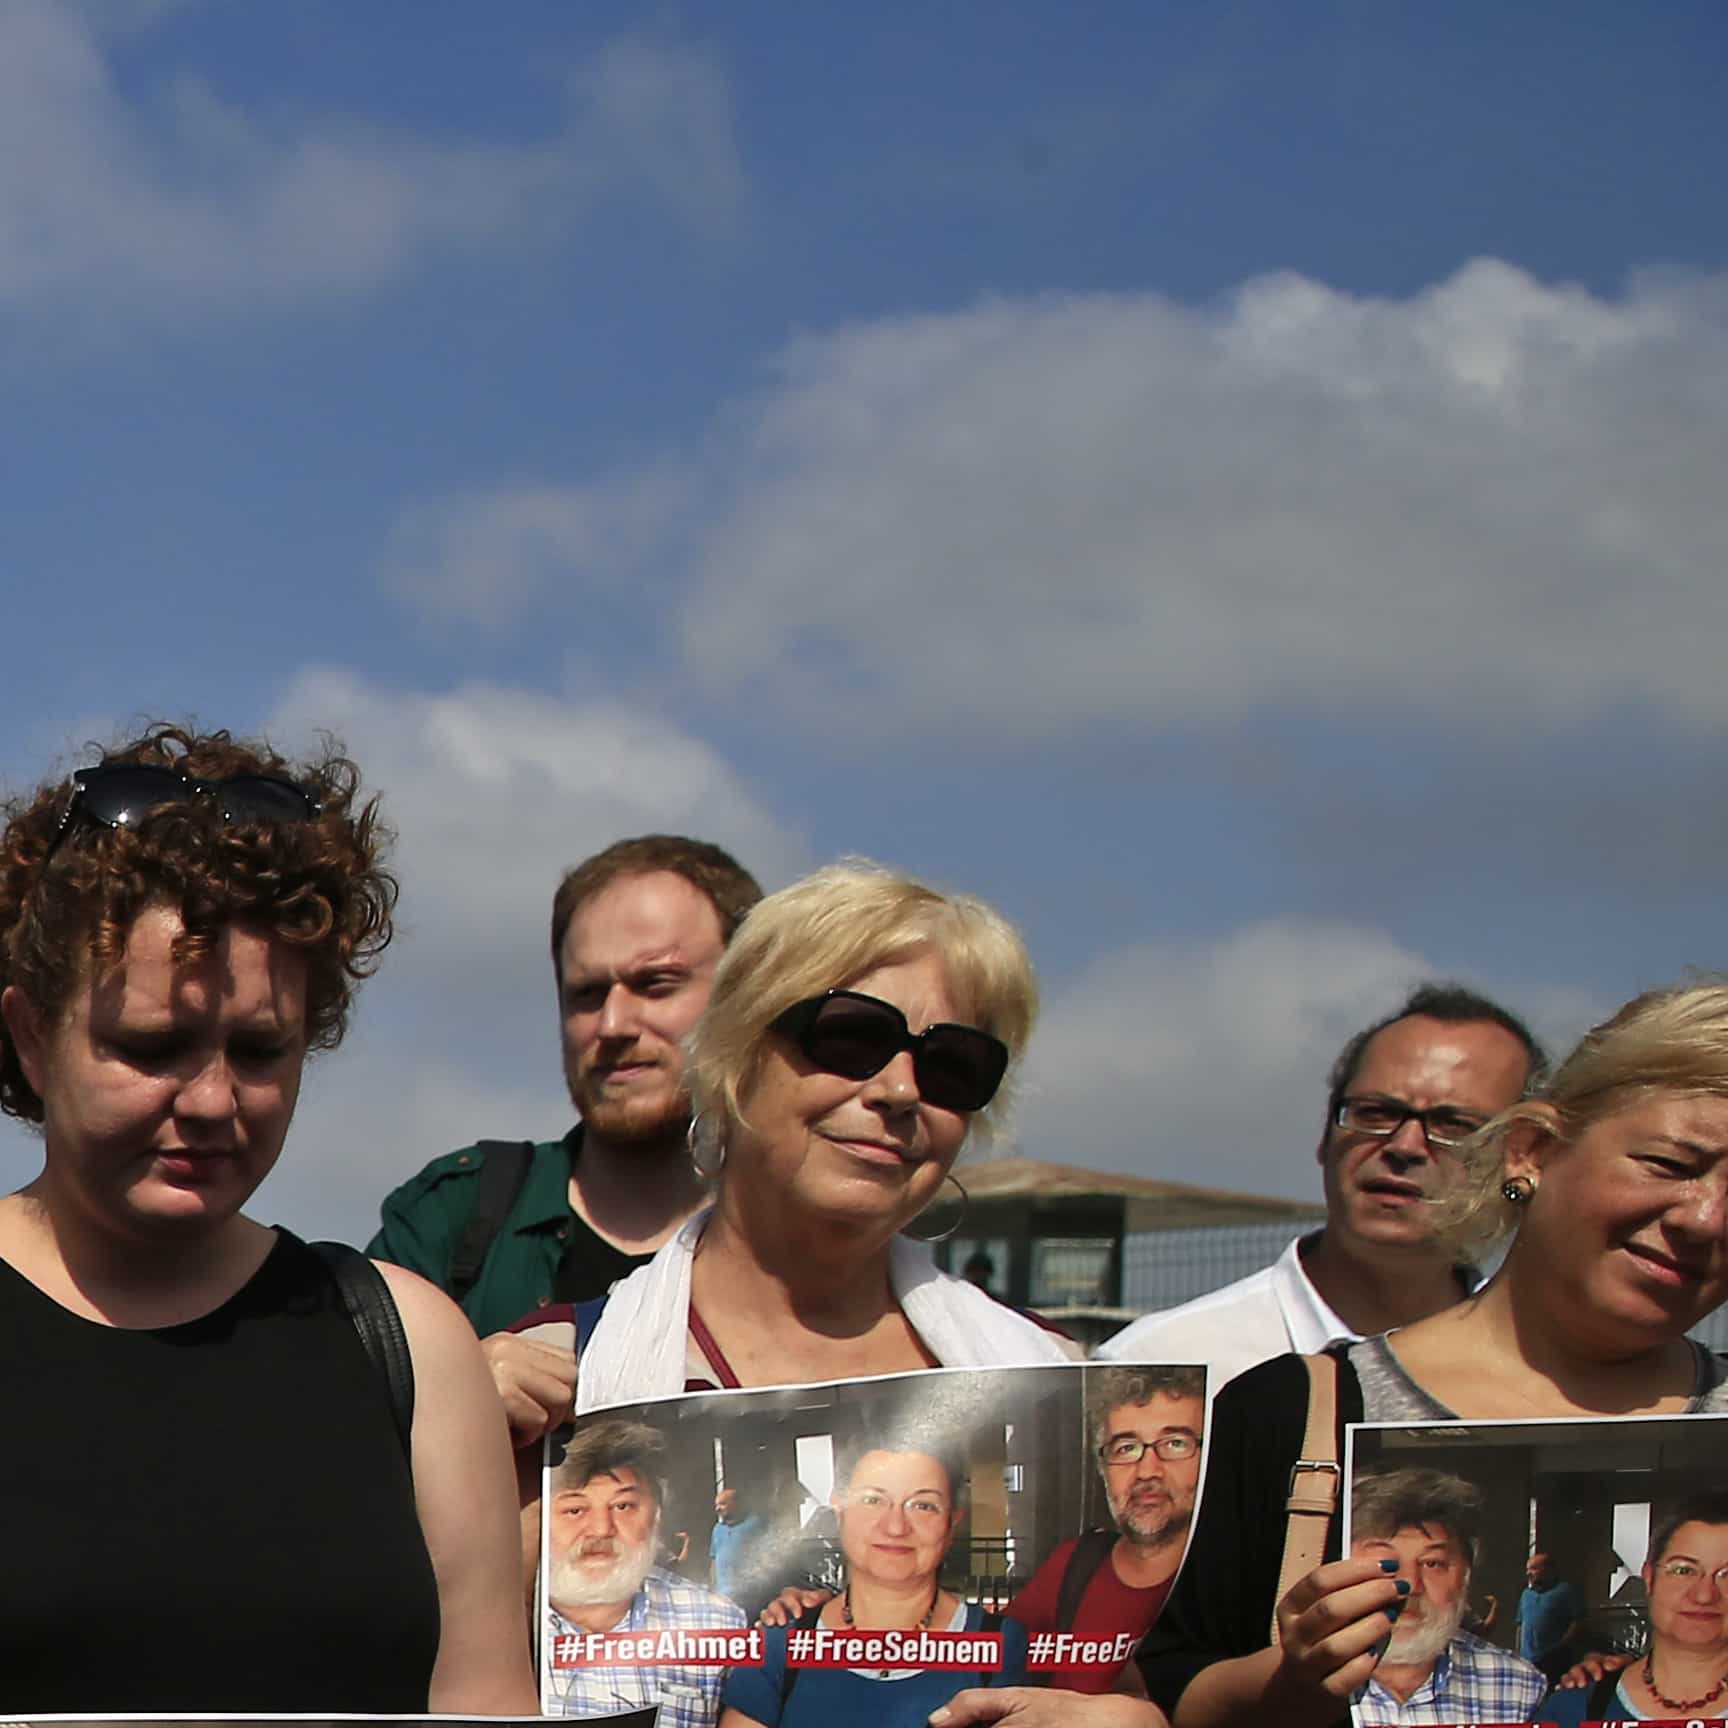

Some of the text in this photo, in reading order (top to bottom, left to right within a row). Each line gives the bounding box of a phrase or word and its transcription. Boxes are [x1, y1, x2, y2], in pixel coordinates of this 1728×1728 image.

[555, 1630, 1136, 1665] #FreeAhmet #FreeSebnem #FreeEr
